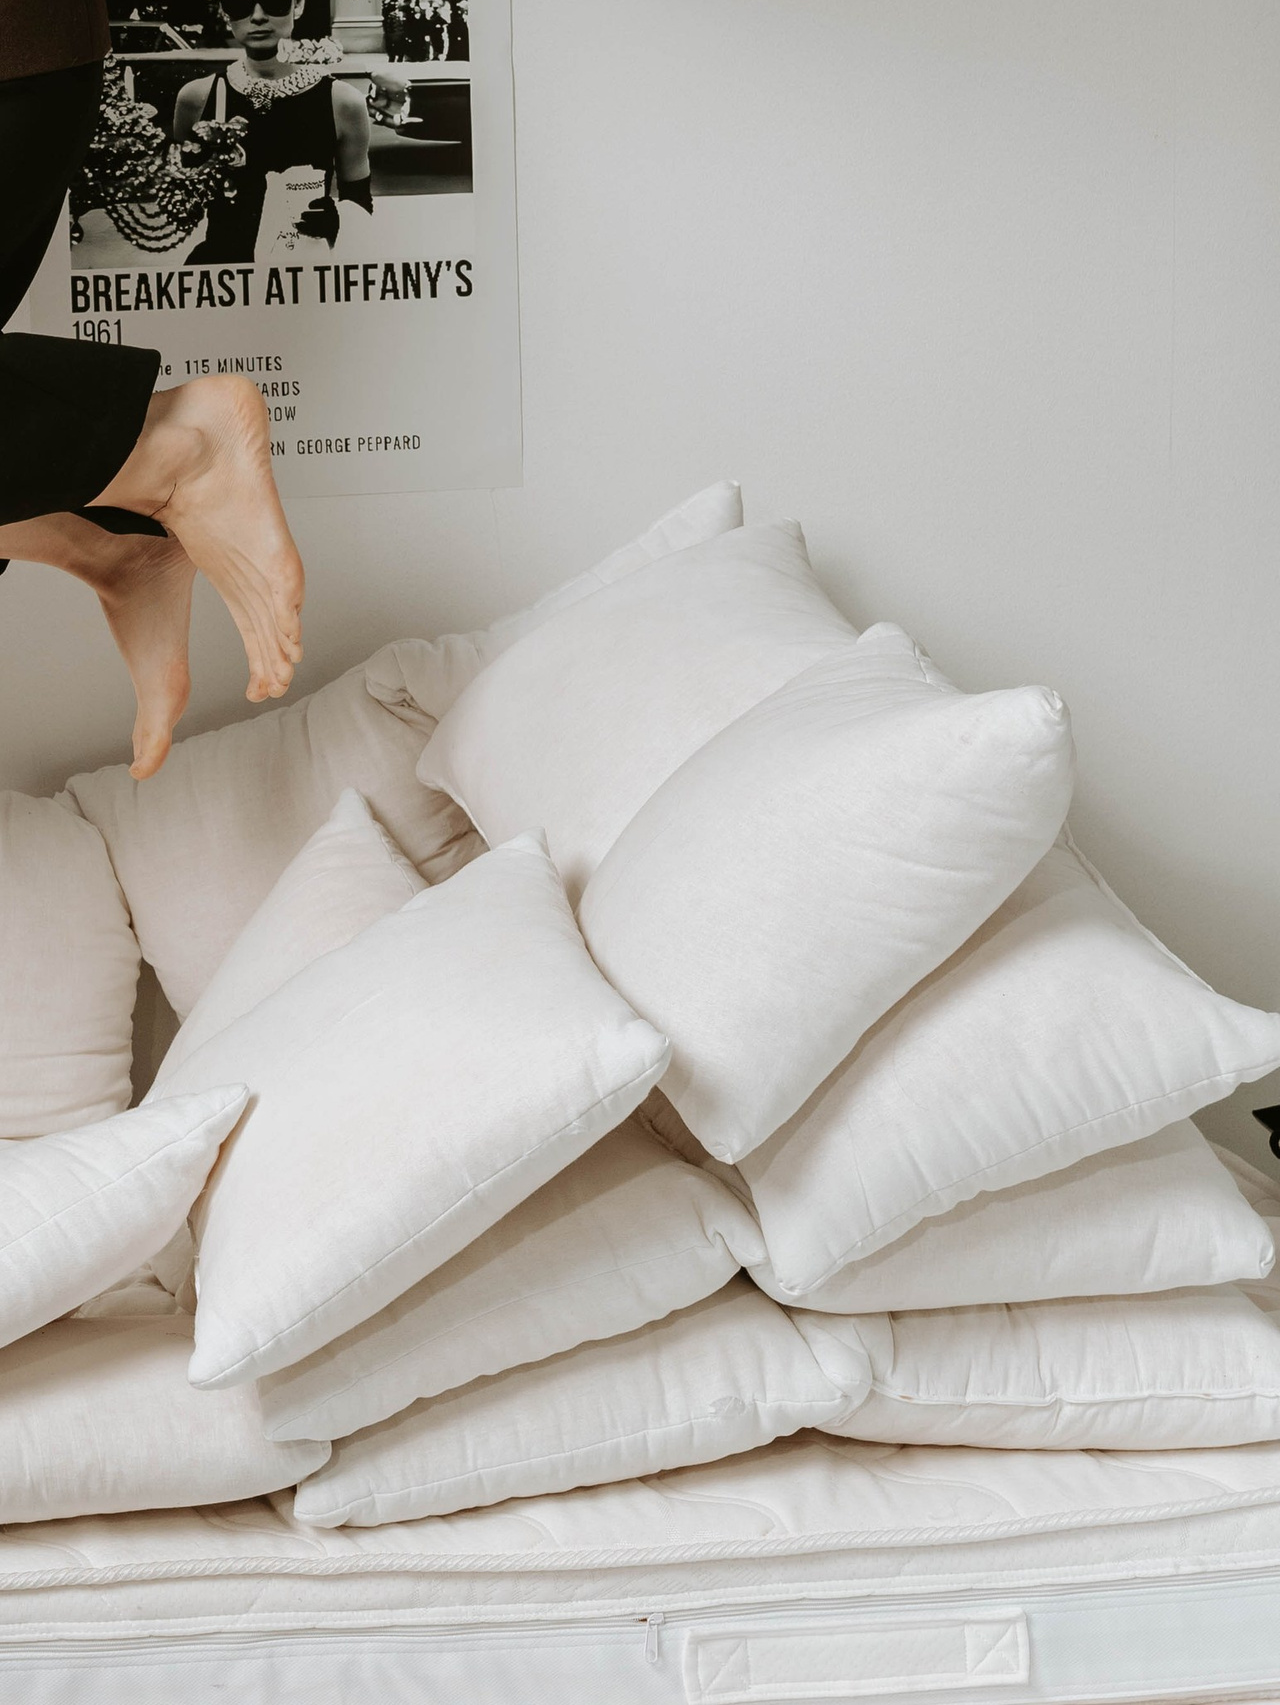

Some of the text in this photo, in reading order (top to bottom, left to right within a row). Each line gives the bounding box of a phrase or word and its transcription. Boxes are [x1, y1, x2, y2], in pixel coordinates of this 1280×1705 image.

[71, 259, 473, 313] BREAKFAST AT TIFFANY'S
[72, 319, 122, 345] 1961
[185, 359, 210, 374] 115
[218, 356, 282, 373] MINUTES
[256, 381, 300, 397] ARDS
[297, 438, 351, 455] GEORGE
[358, 435, 421, 452] PEPPARD
